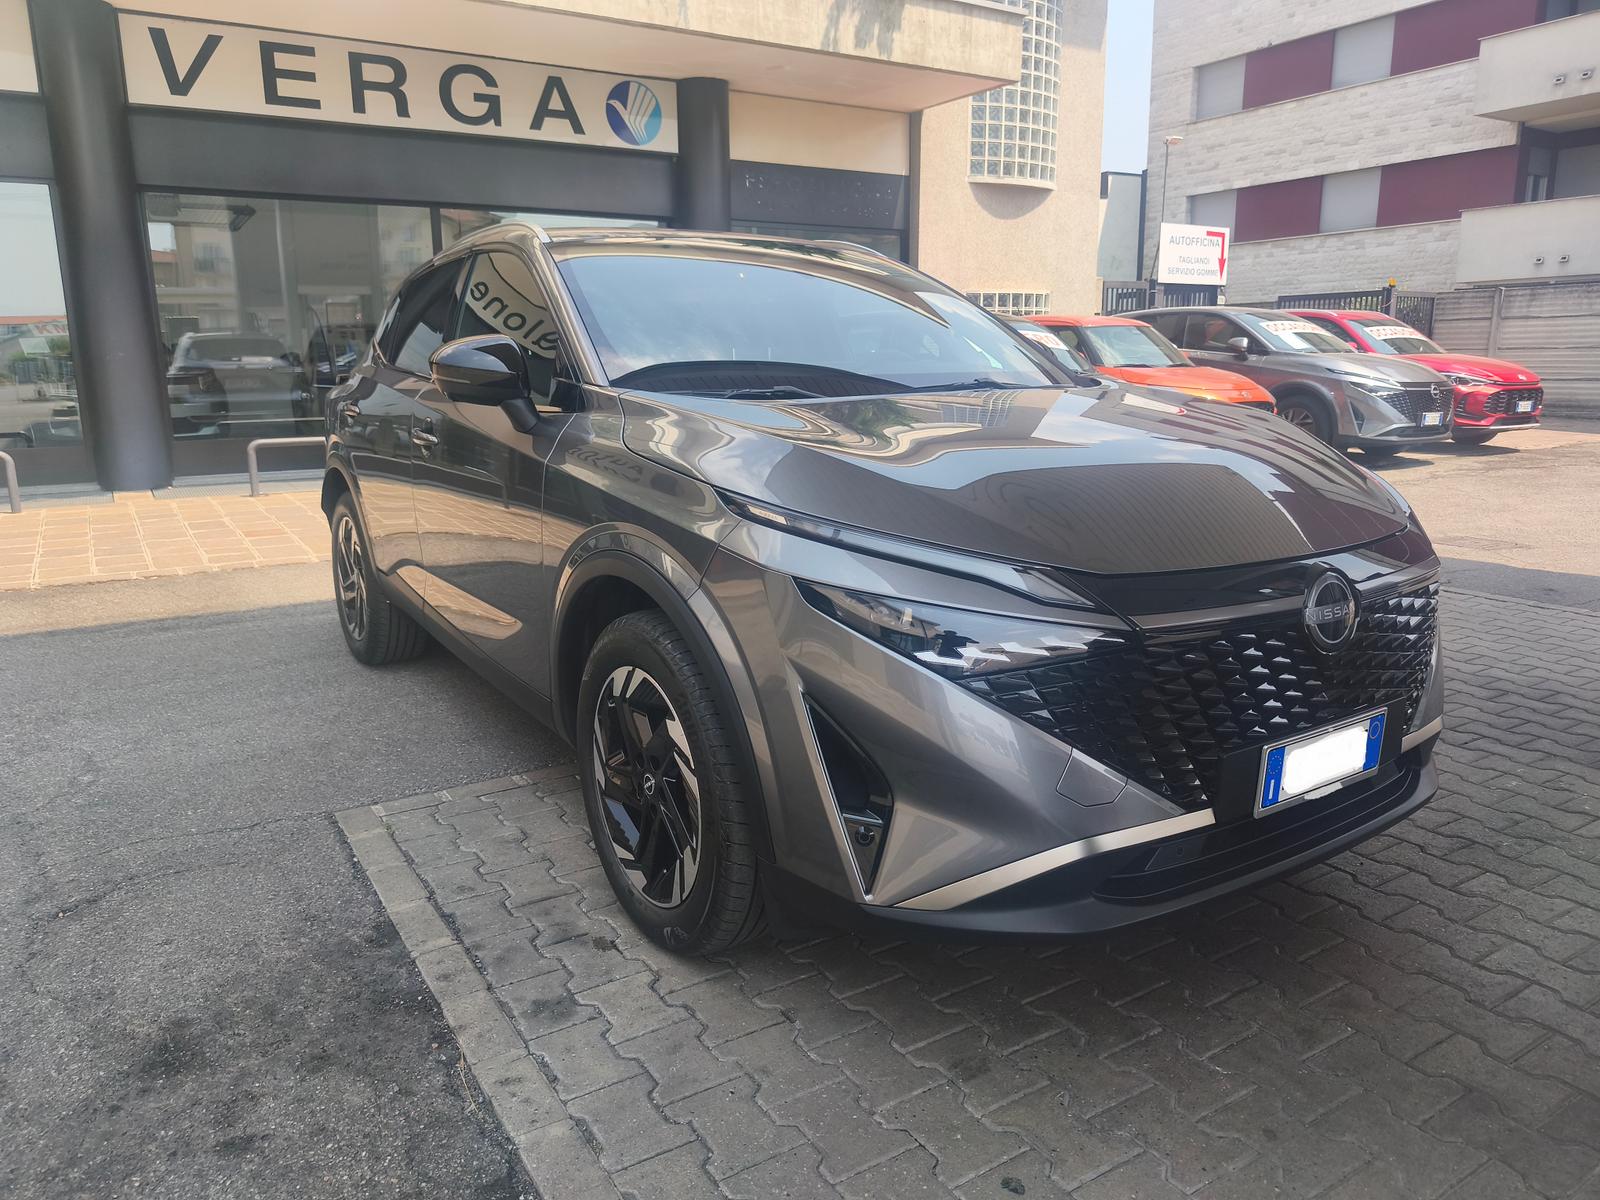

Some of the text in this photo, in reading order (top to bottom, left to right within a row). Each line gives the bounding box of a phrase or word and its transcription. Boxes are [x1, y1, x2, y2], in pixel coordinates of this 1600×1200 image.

[147, 26, 587, 137] VERGA
[1169, 235, 1220, 248] AUTOFFICINA
[1305, 603, 1354, 622] NISSA
